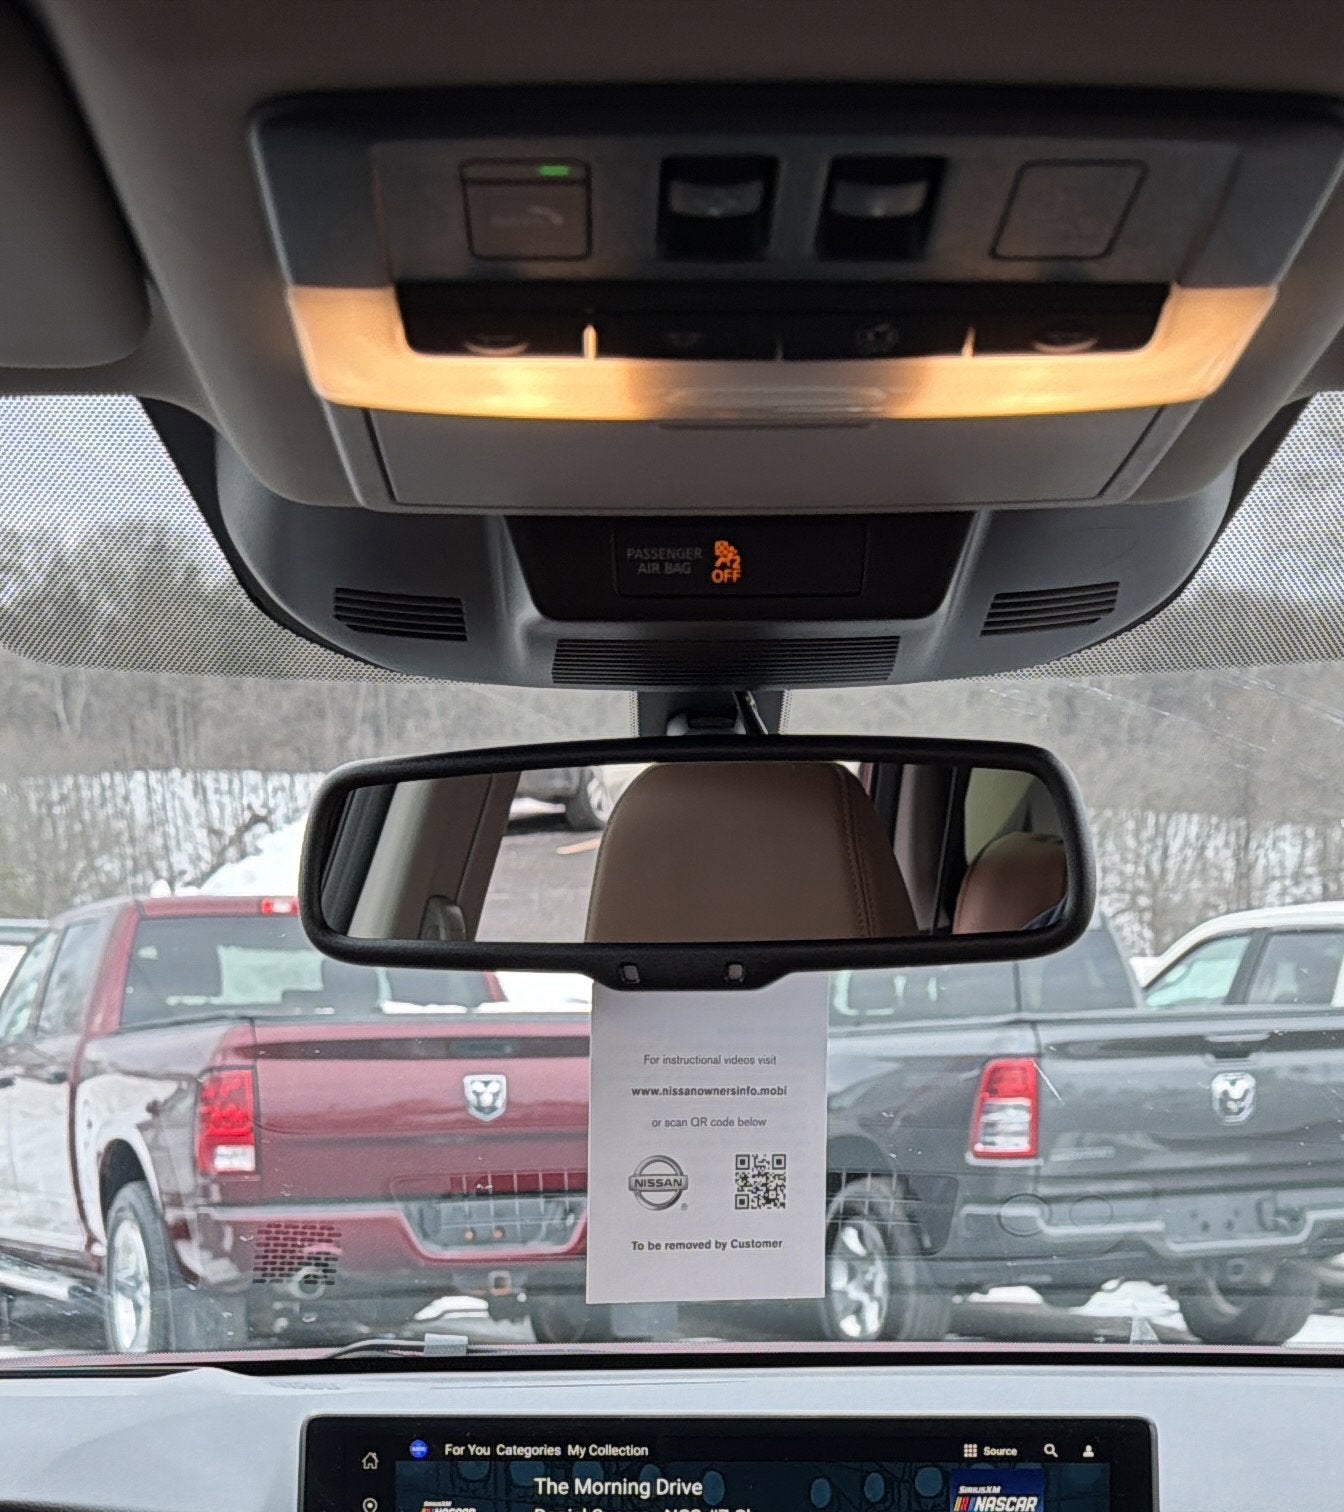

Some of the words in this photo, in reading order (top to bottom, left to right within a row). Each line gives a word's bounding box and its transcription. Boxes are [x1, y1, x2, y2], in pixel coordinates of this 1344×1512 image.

[627, 548, 702, 560] PASSENGER
[638, 563, 661, 574] AIR
[665, 562, 692, 574] BAG
[711, 570, 741, 584] OFF
[643, 1055, 659, 1065] For
[662, 1054, 721, 1065] instructional
[724, 1054, 755, 1065] videos
[758, 1055, 777, 1065] visit
[631, 1086, 788, 1097] www.nissanownersinfo.mobi
[652, 1119, 661, 1127] or
[664, 1119, 688, 1127] scan
[690, 1117, 708, 1128] QR
[710, 1117, 735, 1127] code
[737, 1117, 767, 1127] below
[634, 1178, 683, 1188] NISSAN
[632, 1241, 645, 1251] To
[648, 1240, 662, 1251] be
[664, 1239, 712, 1250] removed
[715, 1239, 727, 1252] by
[730, 1238, 783, 1249] Customer
[445, 1444, 465, 1456] For
[468, 1444, 490, 1456] You
[496, 1444, 561, 1458] Categories
[567, 1445, 586, 1458] My
[588, 1445, 648, 1457] Collection
[983, 1446, 1017, 1457] Source
[534, 1478, 569, 1495] The
[574, 1478, 651, 1499] Morning
[656, 1478, 703, 1496] Drive
[974, 1496, 1038, 1512] NASCAR
